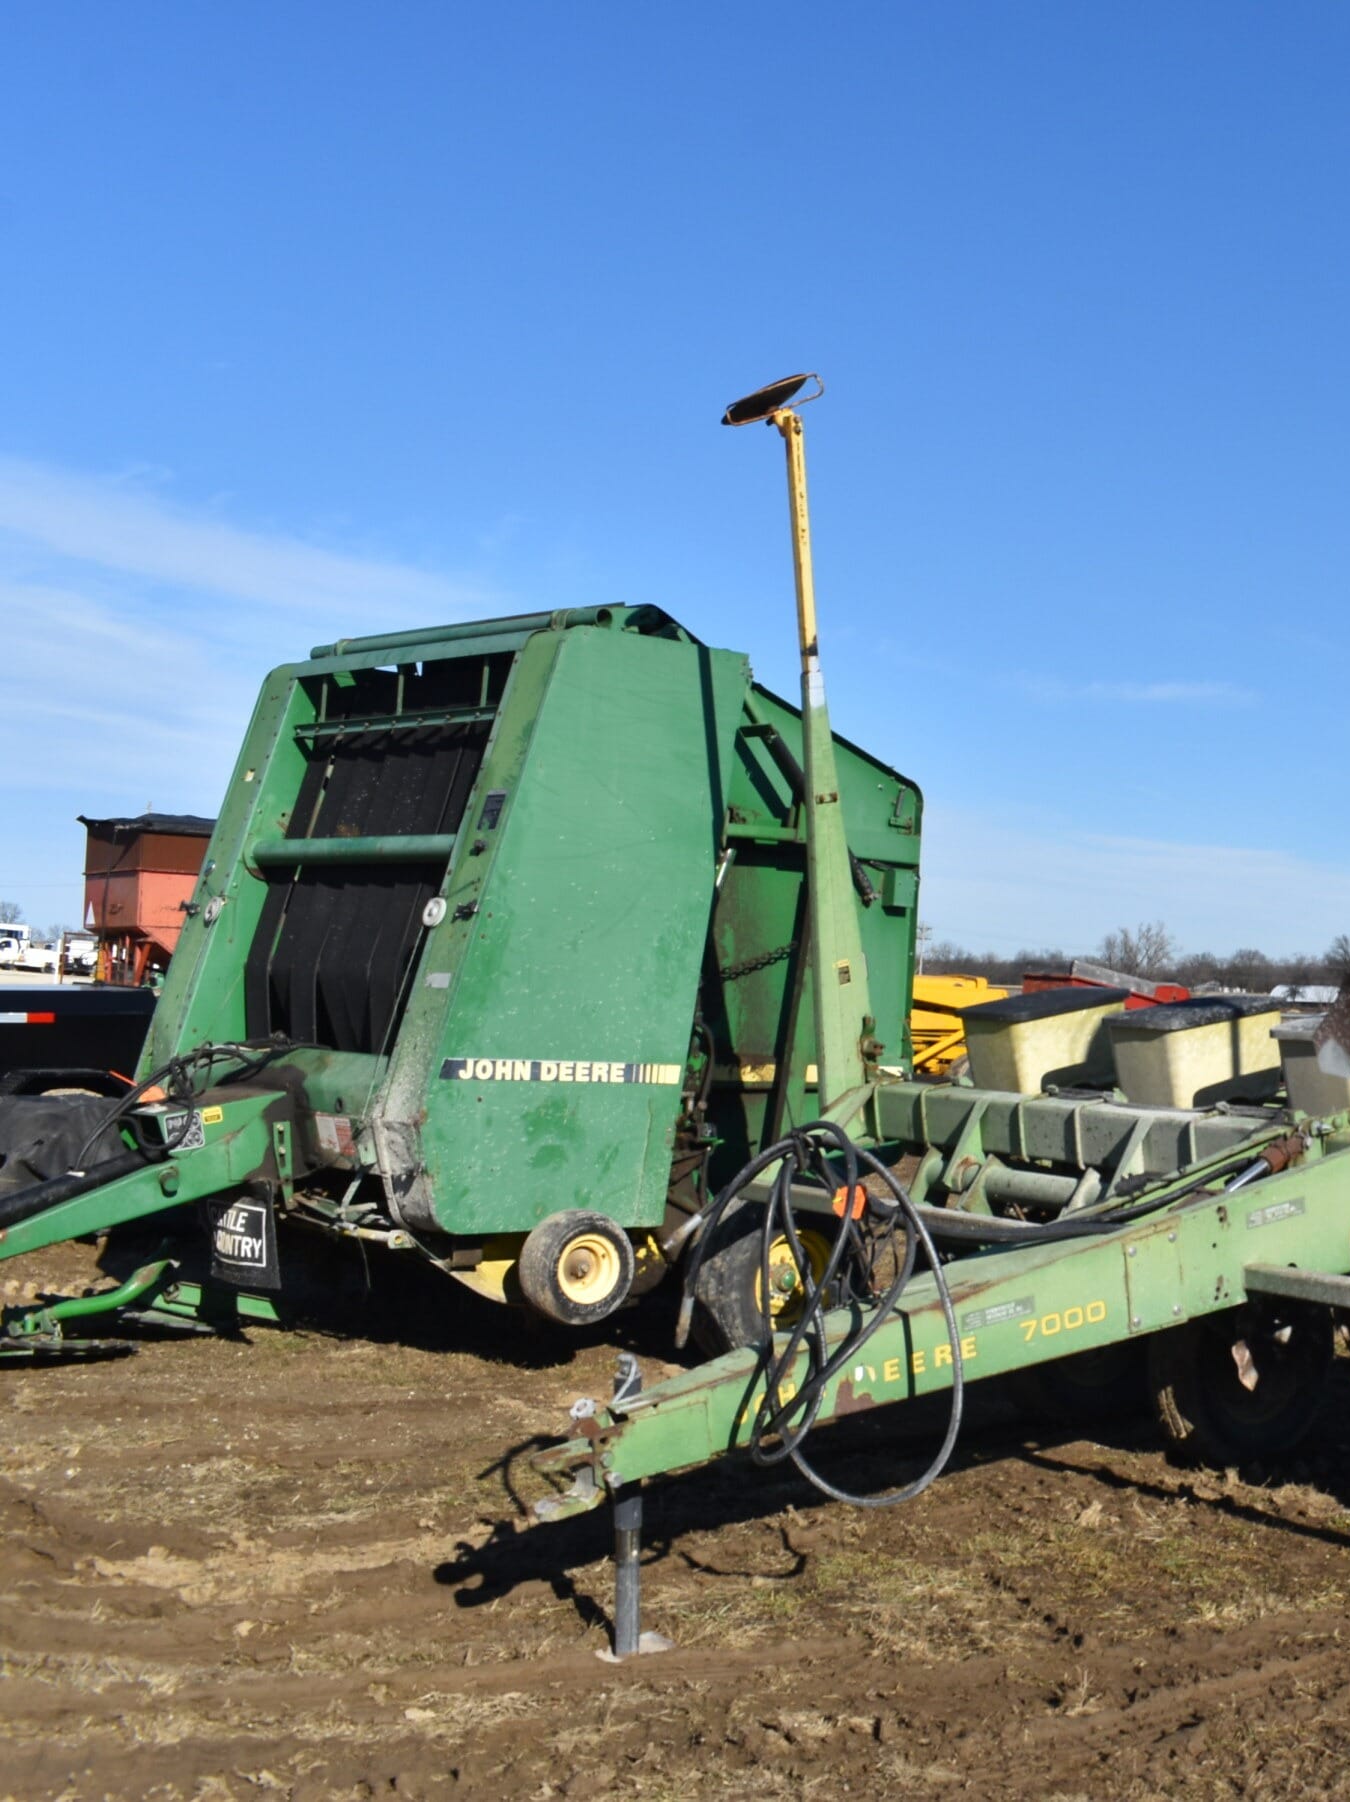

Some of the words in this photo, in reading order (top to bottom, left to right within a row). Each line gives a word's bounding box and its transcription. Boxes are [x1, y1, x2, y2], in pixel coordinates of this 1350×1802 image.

[458, 1058, 531, 1081] JOHN
[539, 1061, 626, 1083] DEERE
[213, 1229, 262, 1259] OUNTRY
[1019, 1300, 1108, 1342] 7000
